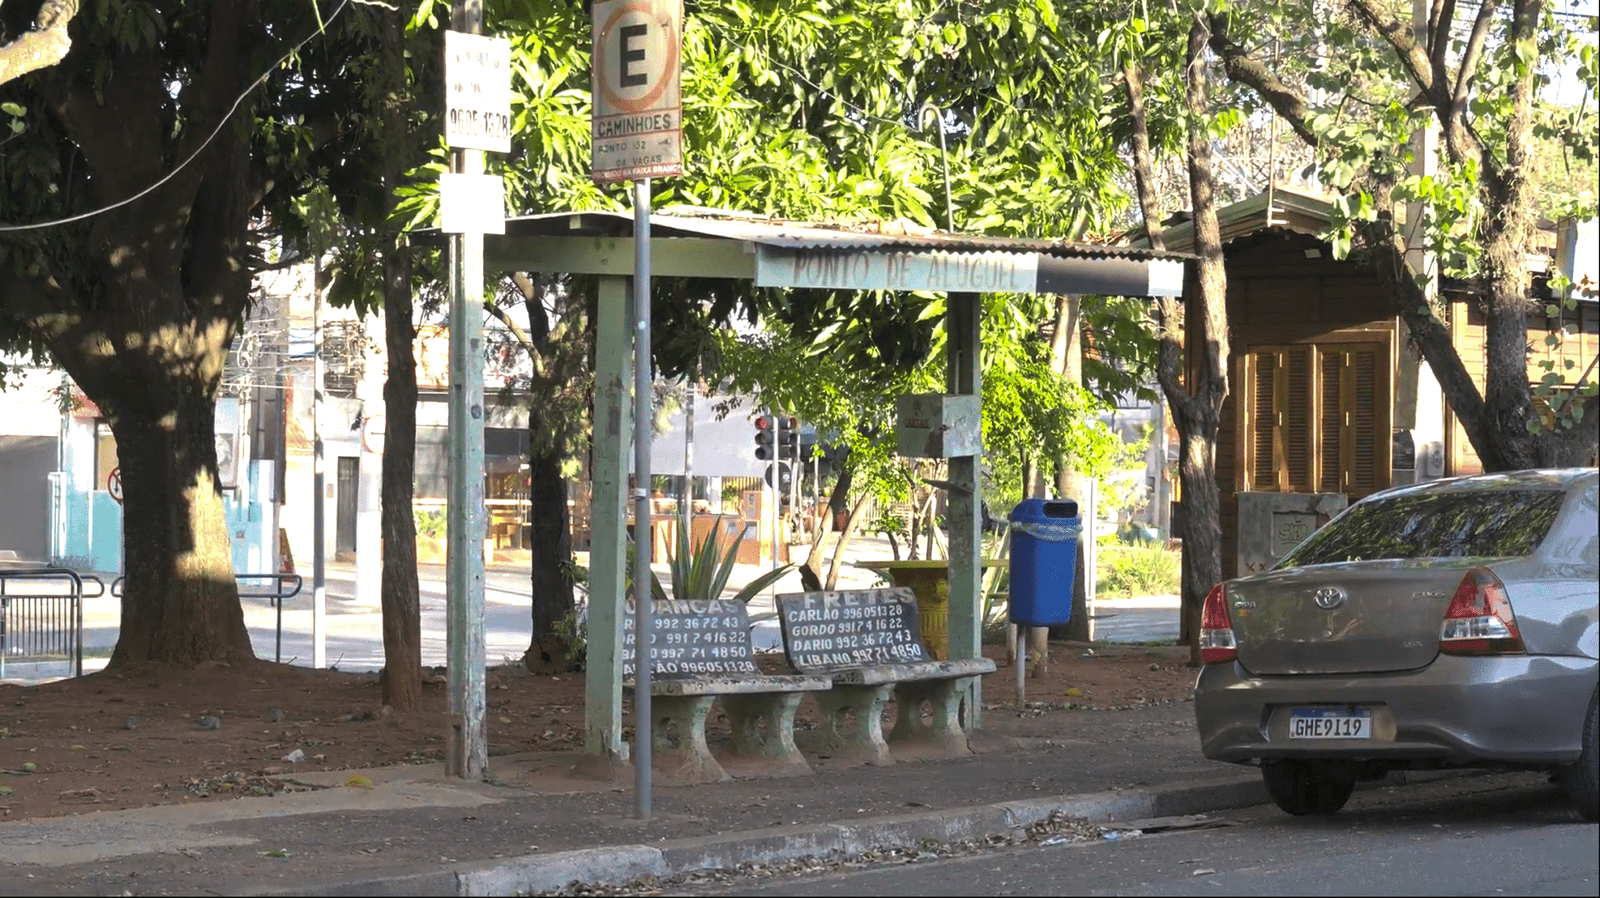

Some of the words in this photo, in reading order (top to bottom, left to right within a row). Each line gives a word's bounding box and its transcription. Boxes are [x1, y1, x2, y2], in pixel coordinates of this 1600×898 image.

[620, 24, 647, 88] E
[598, 142, 627, 154] PONTO
[633, 154, 662, 166] VAGAS
[632, 166, 652, 175] FAIXA
[794, 252, 869, 287] PONTO
[887, 252, 913, 288] DE
[927, 255, 1021, 290] ALUGUEL
[624, 600, 739, 617] UANÇAS
[792, 624, 835, 636] GORDO
[799, 652, 850, 666] LIBANO
[1296, 719, 1362, 736] GHE9I19
